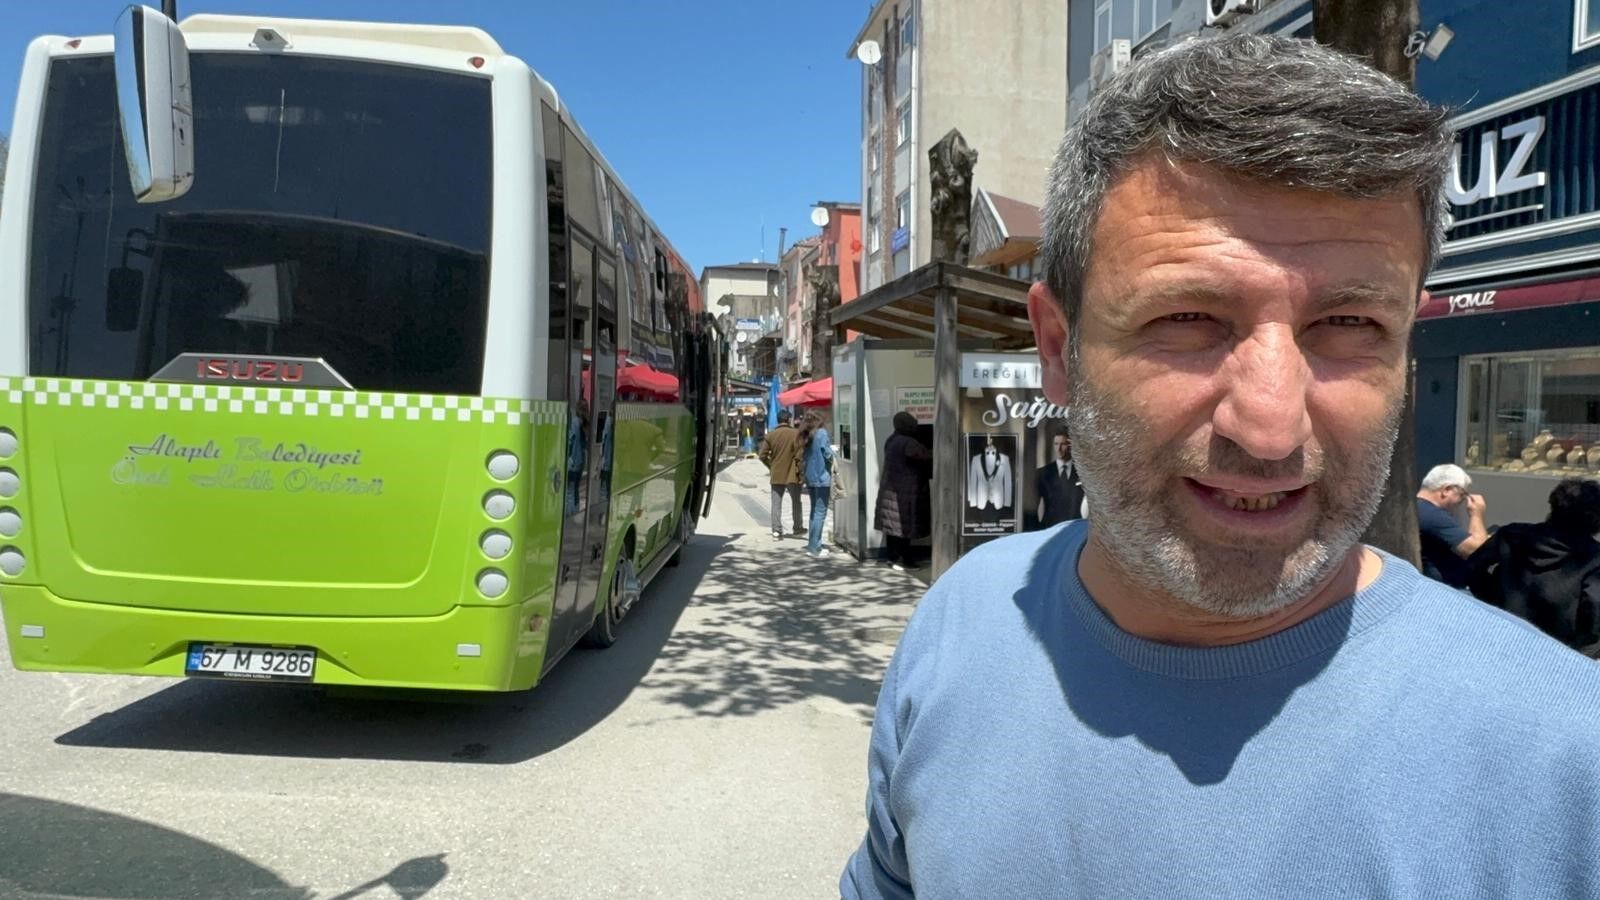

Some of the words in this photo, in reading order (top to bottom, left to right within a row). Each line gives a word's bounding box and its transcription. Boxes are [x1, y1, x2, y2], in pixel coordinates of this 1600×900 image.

[197, 359, 304, 382] ISUZU
[200, 648, 226, 668] 67
[233, 650, 253, 670] M
[260, 651, 312, 673] 9286
